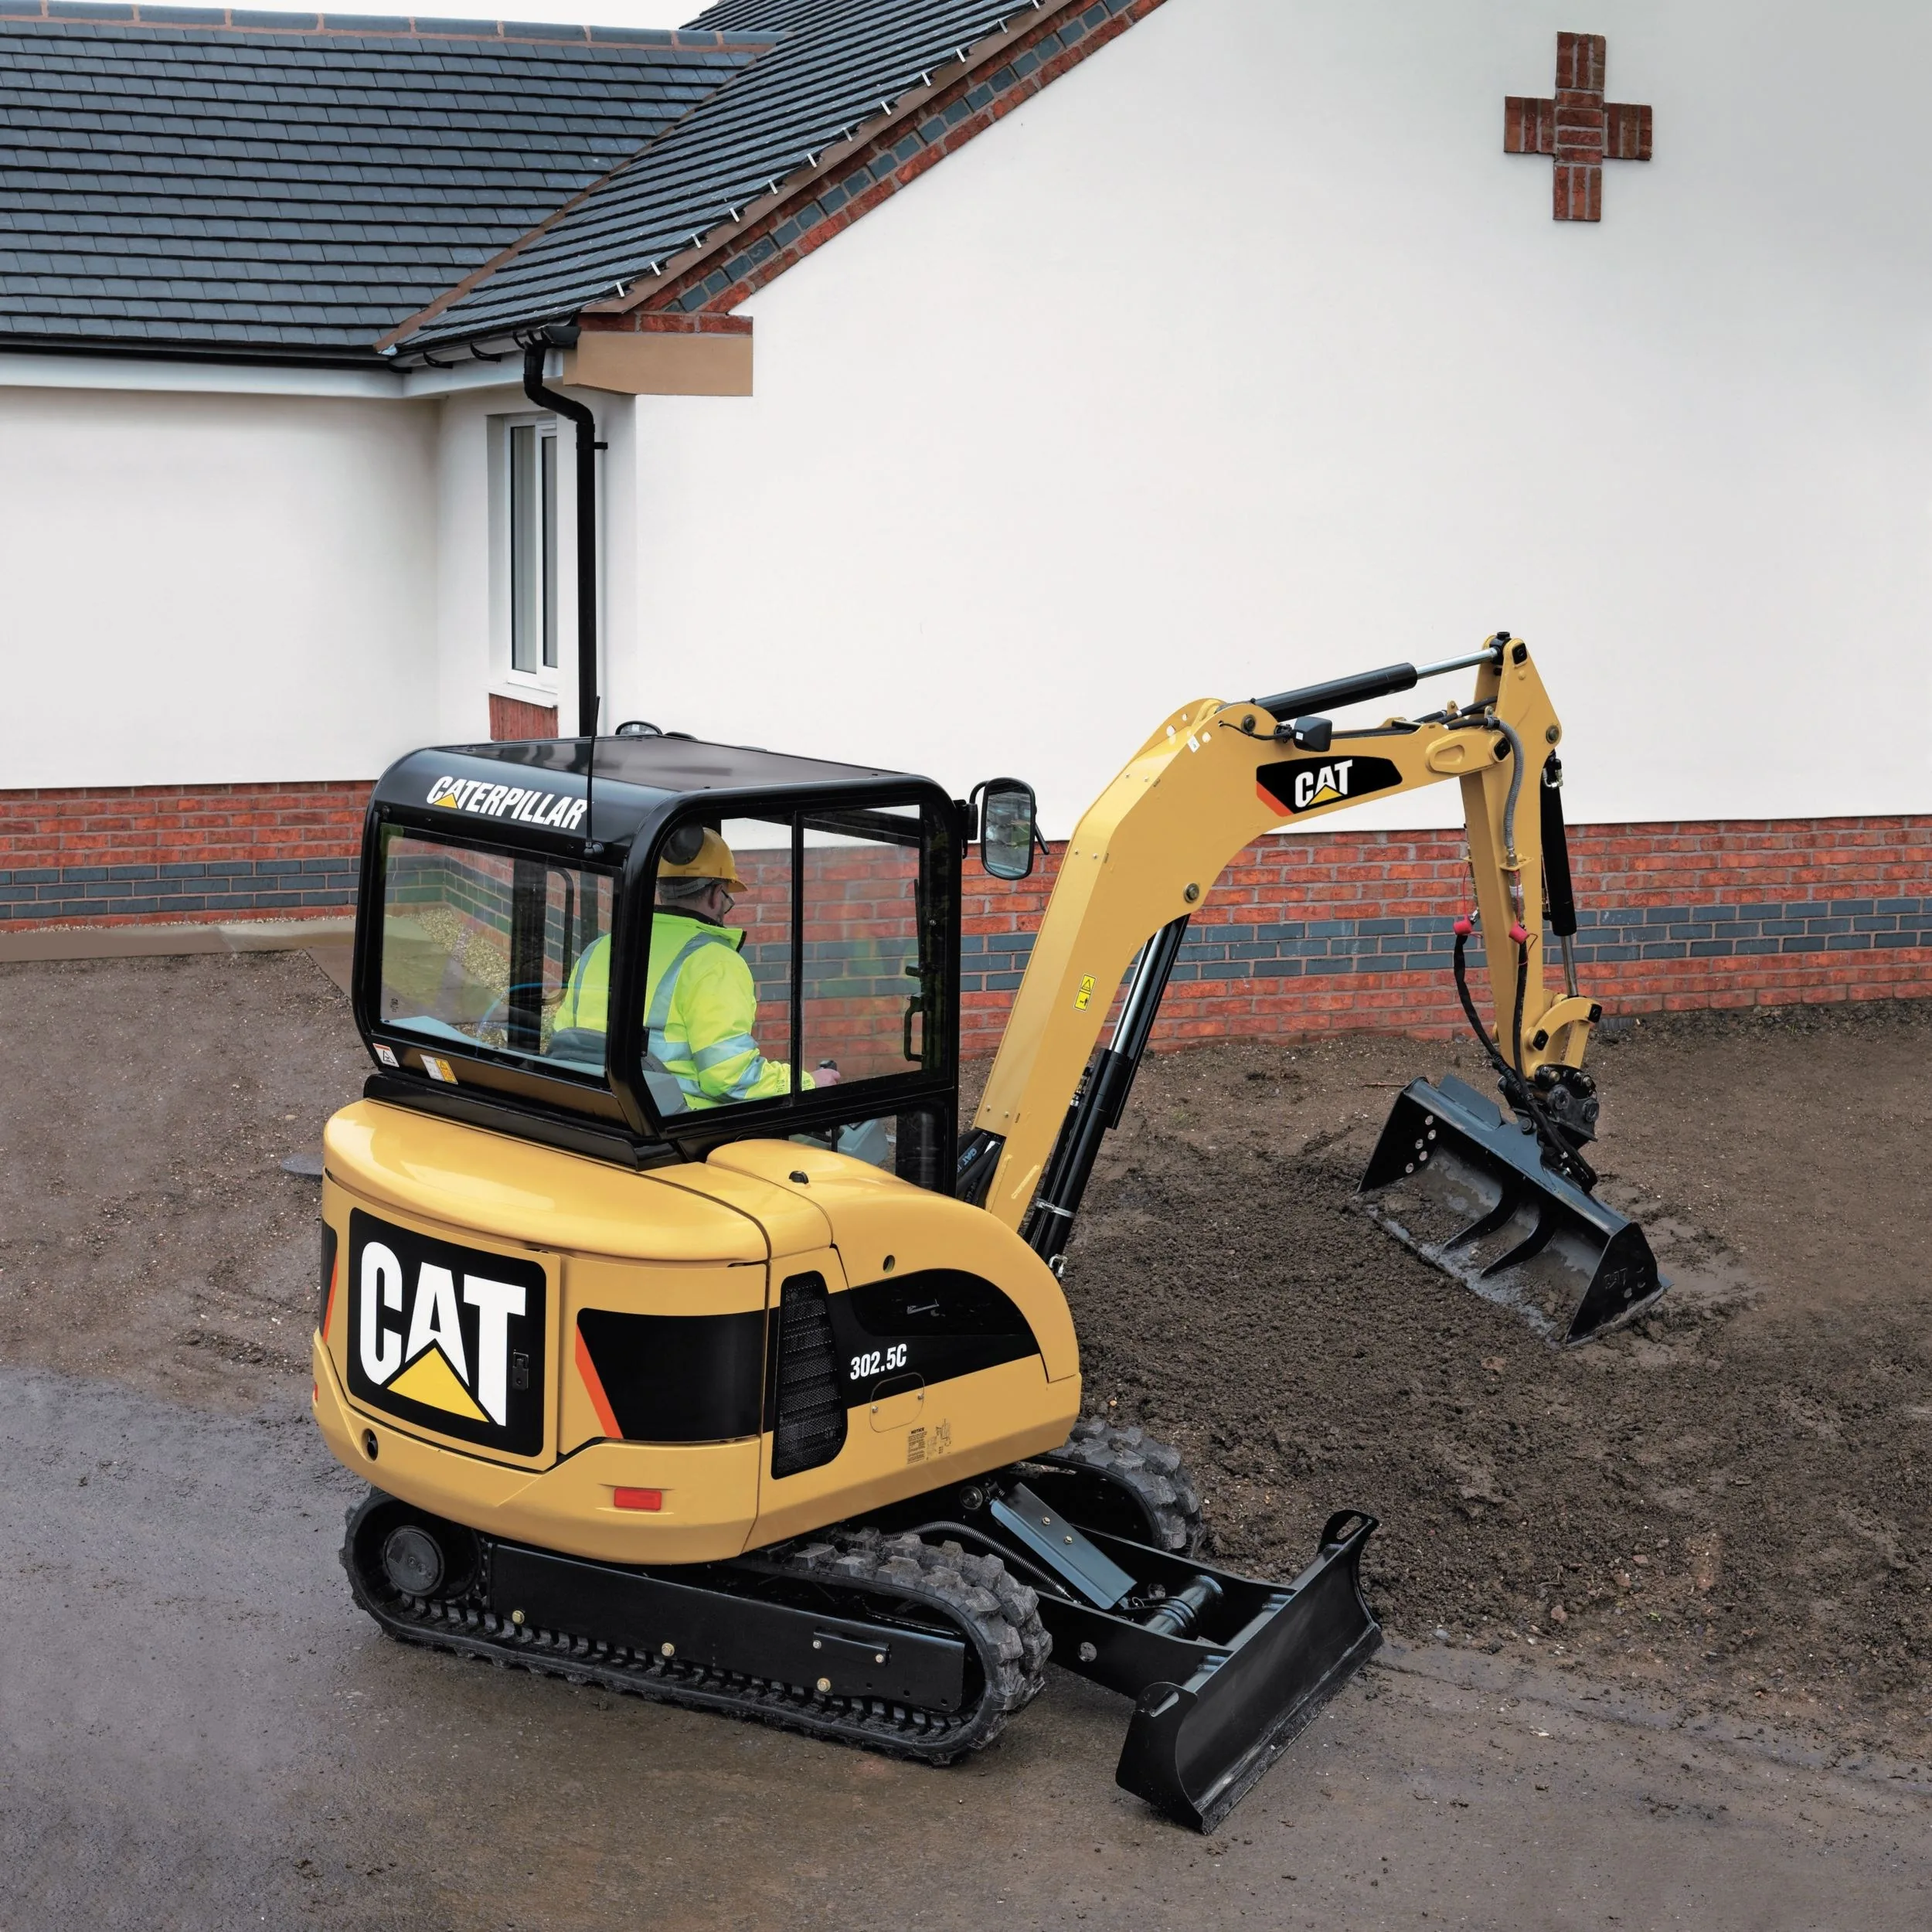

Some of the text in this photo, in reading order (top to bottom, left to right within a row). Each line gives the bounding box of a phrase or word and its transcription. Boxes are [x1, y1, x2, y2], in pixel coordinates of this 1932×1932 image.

[426, 775, 588, 830] CATERPILLAR
[1294, 759, 1353, 808] CAT
[360, 1241, 526, 1427] CAT
[850, 1343, 907, 1380] 302.5C
